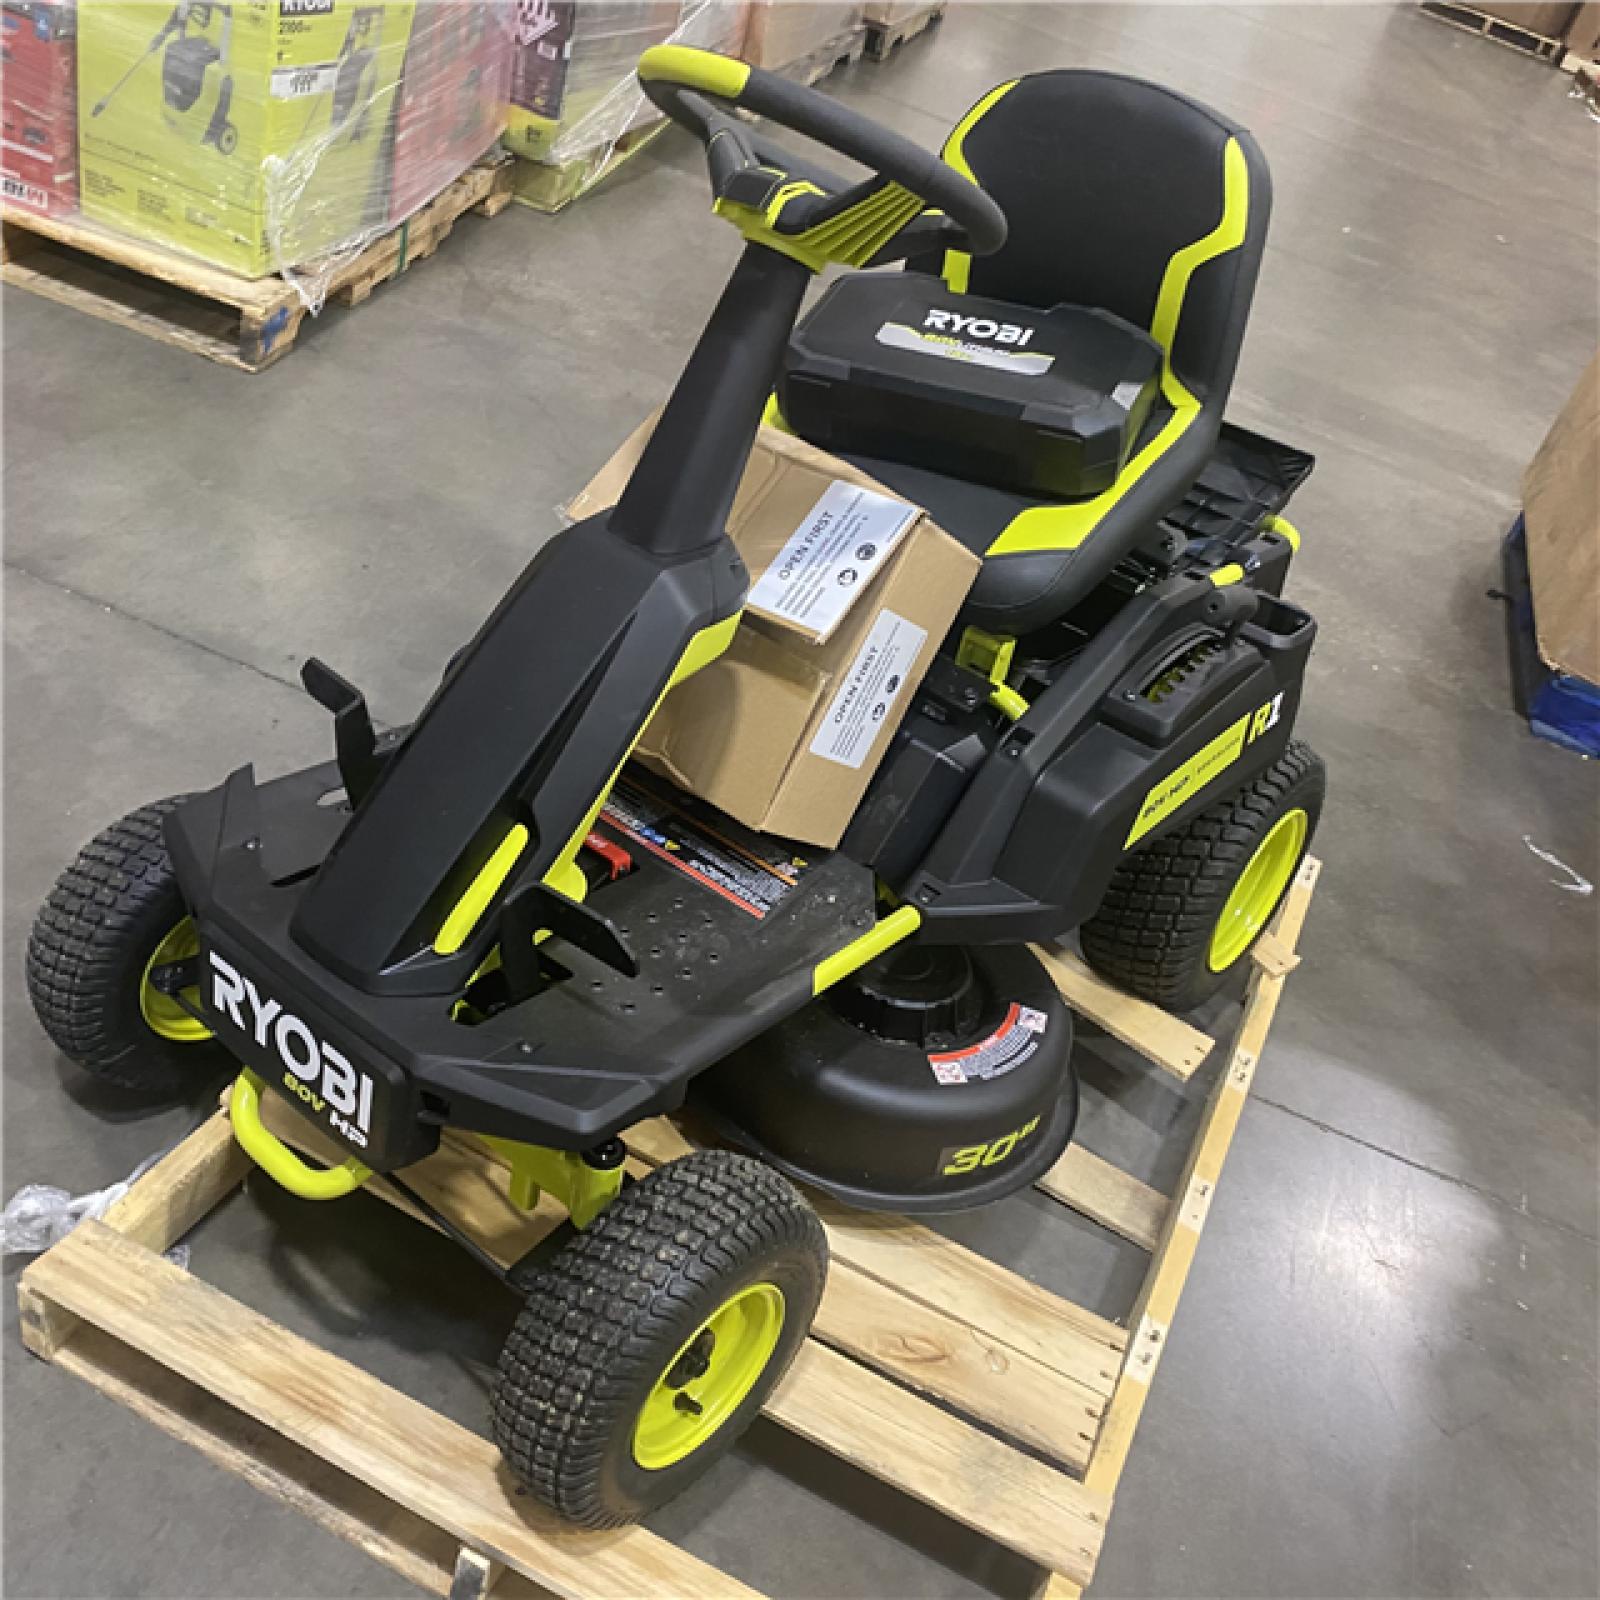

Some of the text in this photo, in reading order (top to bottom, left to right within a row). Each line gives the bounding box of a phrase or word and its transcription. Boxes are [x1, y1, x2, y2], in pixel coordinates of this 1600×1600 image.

[923, 309, 1035, 346] RYOBI
[778, 511, 833, 580] OPEN FIRST
[835, 646, 877, 723] OPEN FIRST
[209, 949, 373, 1133] RYOBI
[943, 1130, 1018, 1176] 30
